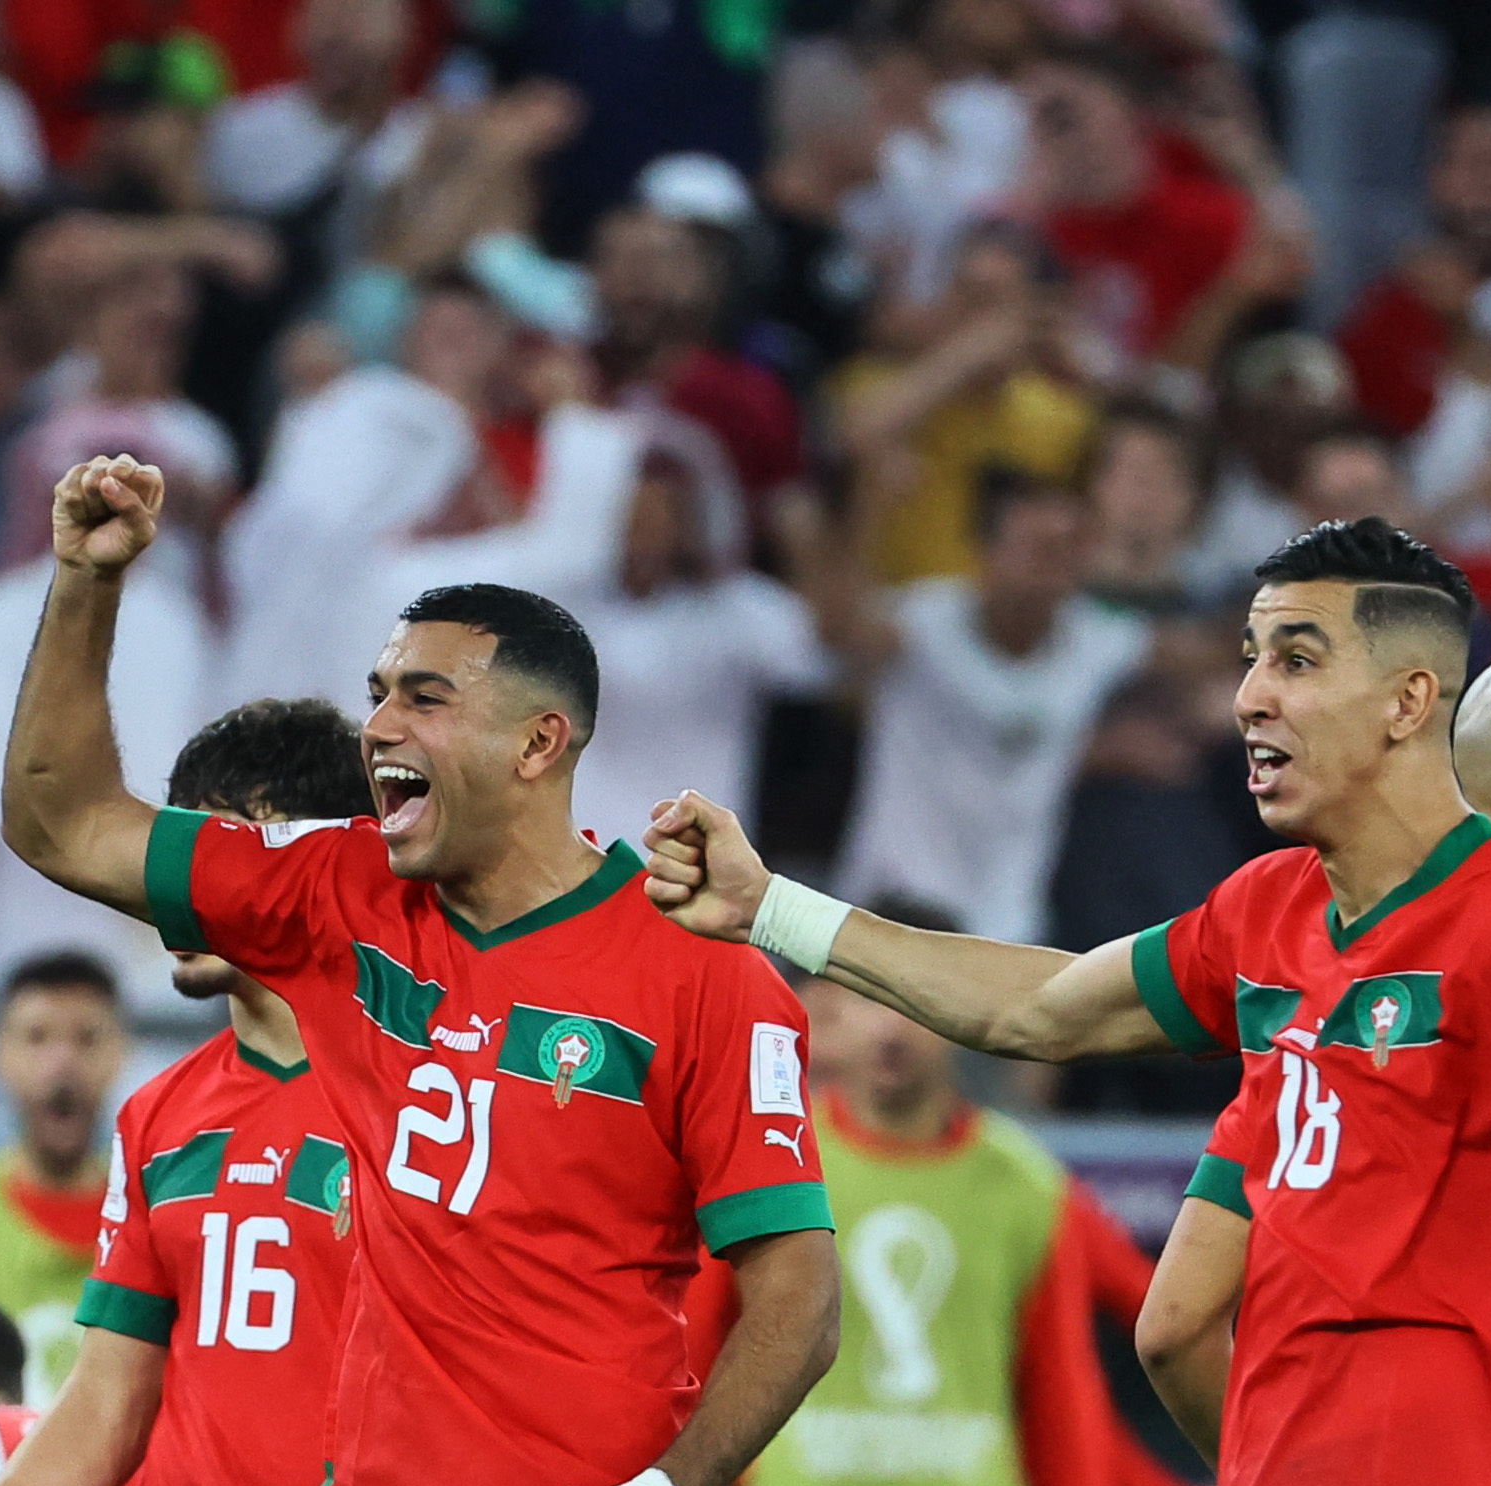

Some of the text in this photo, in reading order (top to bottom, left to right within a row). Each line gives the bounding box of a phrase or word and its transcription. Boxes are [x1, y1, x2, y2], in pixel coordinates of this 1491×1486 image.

[430, 1025, 482, 1052] PUMA
[226, 1163, 276, 1185] PUMA
[385, 1062, 496, 1216] 21
[1266, 1050, 1343, 1190] 18
[197, 1211, 296, 1352] 16
